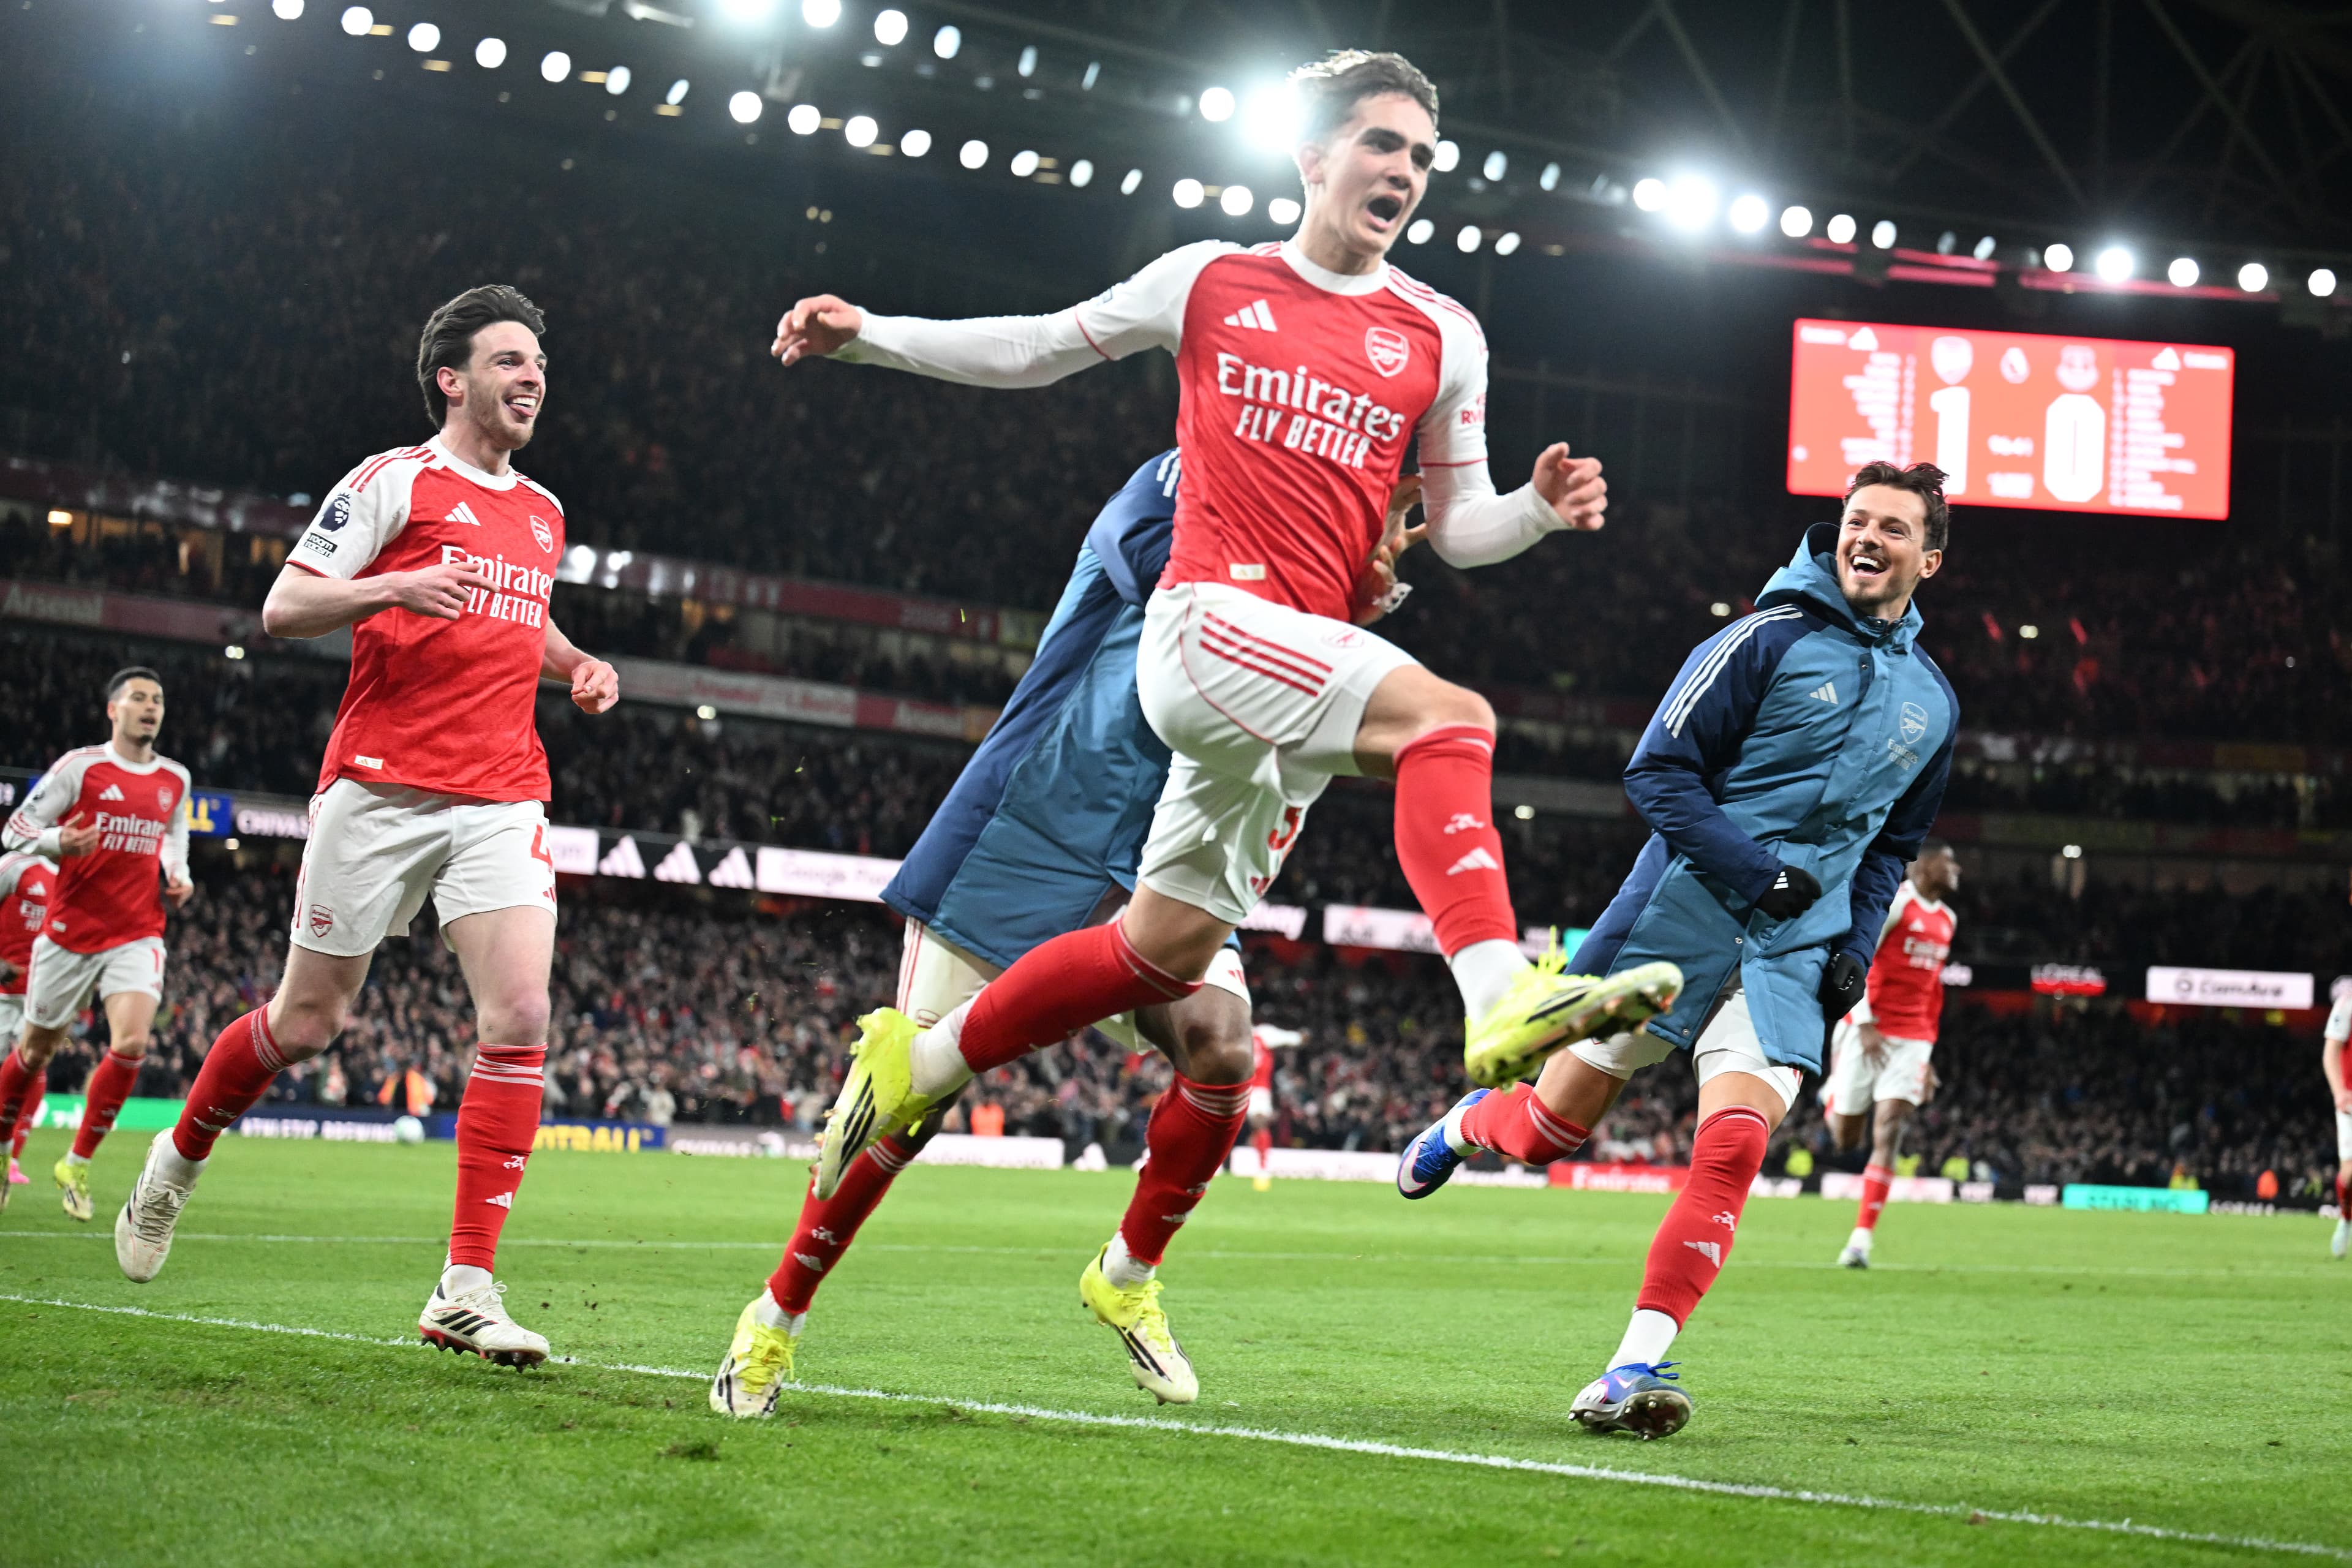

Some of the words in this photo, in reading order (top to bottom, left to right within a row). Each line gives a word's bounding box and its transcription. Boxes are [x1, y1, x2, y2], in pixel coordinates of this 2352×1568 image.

[1217, 352, 1405, 442] Emirates
[1234, 404, 1283, 443] FLY
[1284, 415, 1371, 470] BETTER
[1930, 386, 1970, 495] 1
[2043, 393, 2105, 502] 0
[441, 545, 554, 602] Emirate
[462, 584, 490, 614] LY
[489, 592, 543, 629] BETTER
[1887, 738, 1919, 764] Emirates
[102, 833, 124, 851] FLY
